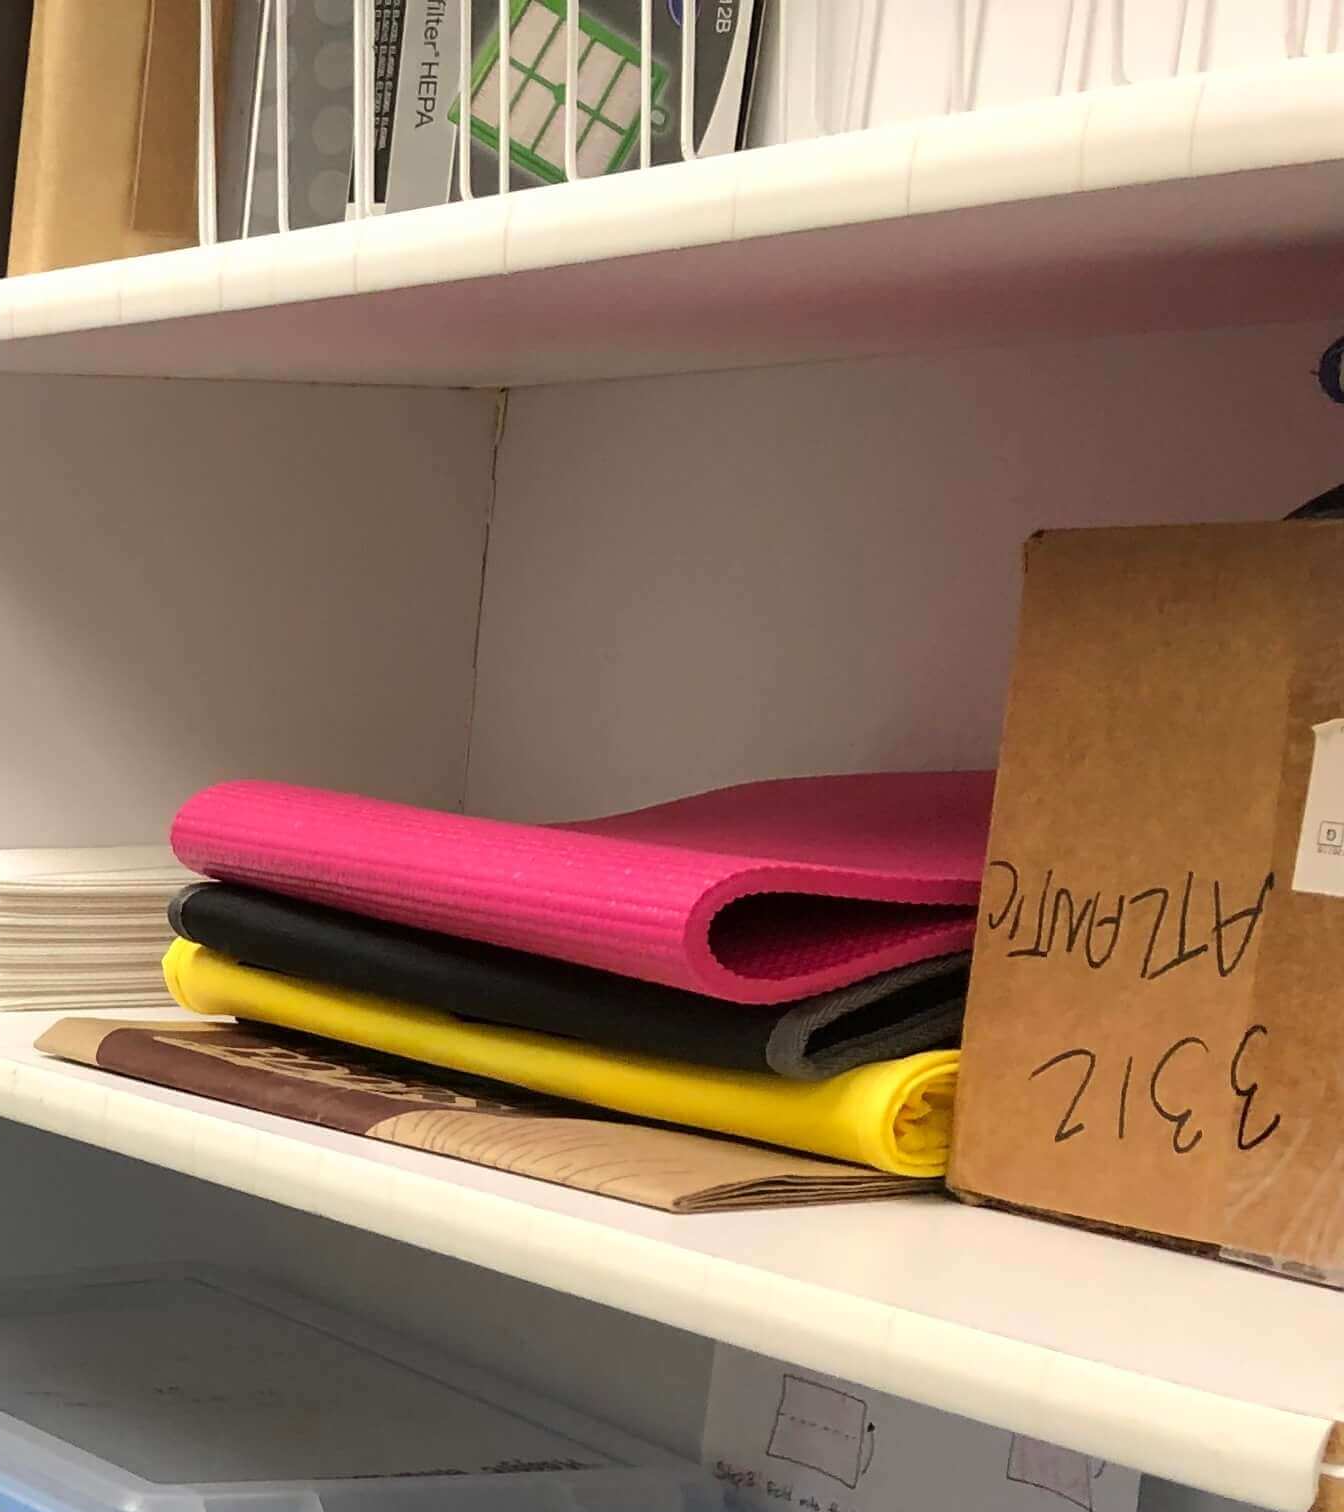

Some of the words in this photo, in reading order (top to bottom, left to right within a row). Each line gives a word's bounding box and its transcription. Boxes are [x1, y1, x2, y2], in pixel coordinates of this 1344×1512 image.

[414, 61, 440, 129] HEPA
[986, 858, 1277, 982] ATLANTIC
[1029, 1024, 1282, 1154] 3312
